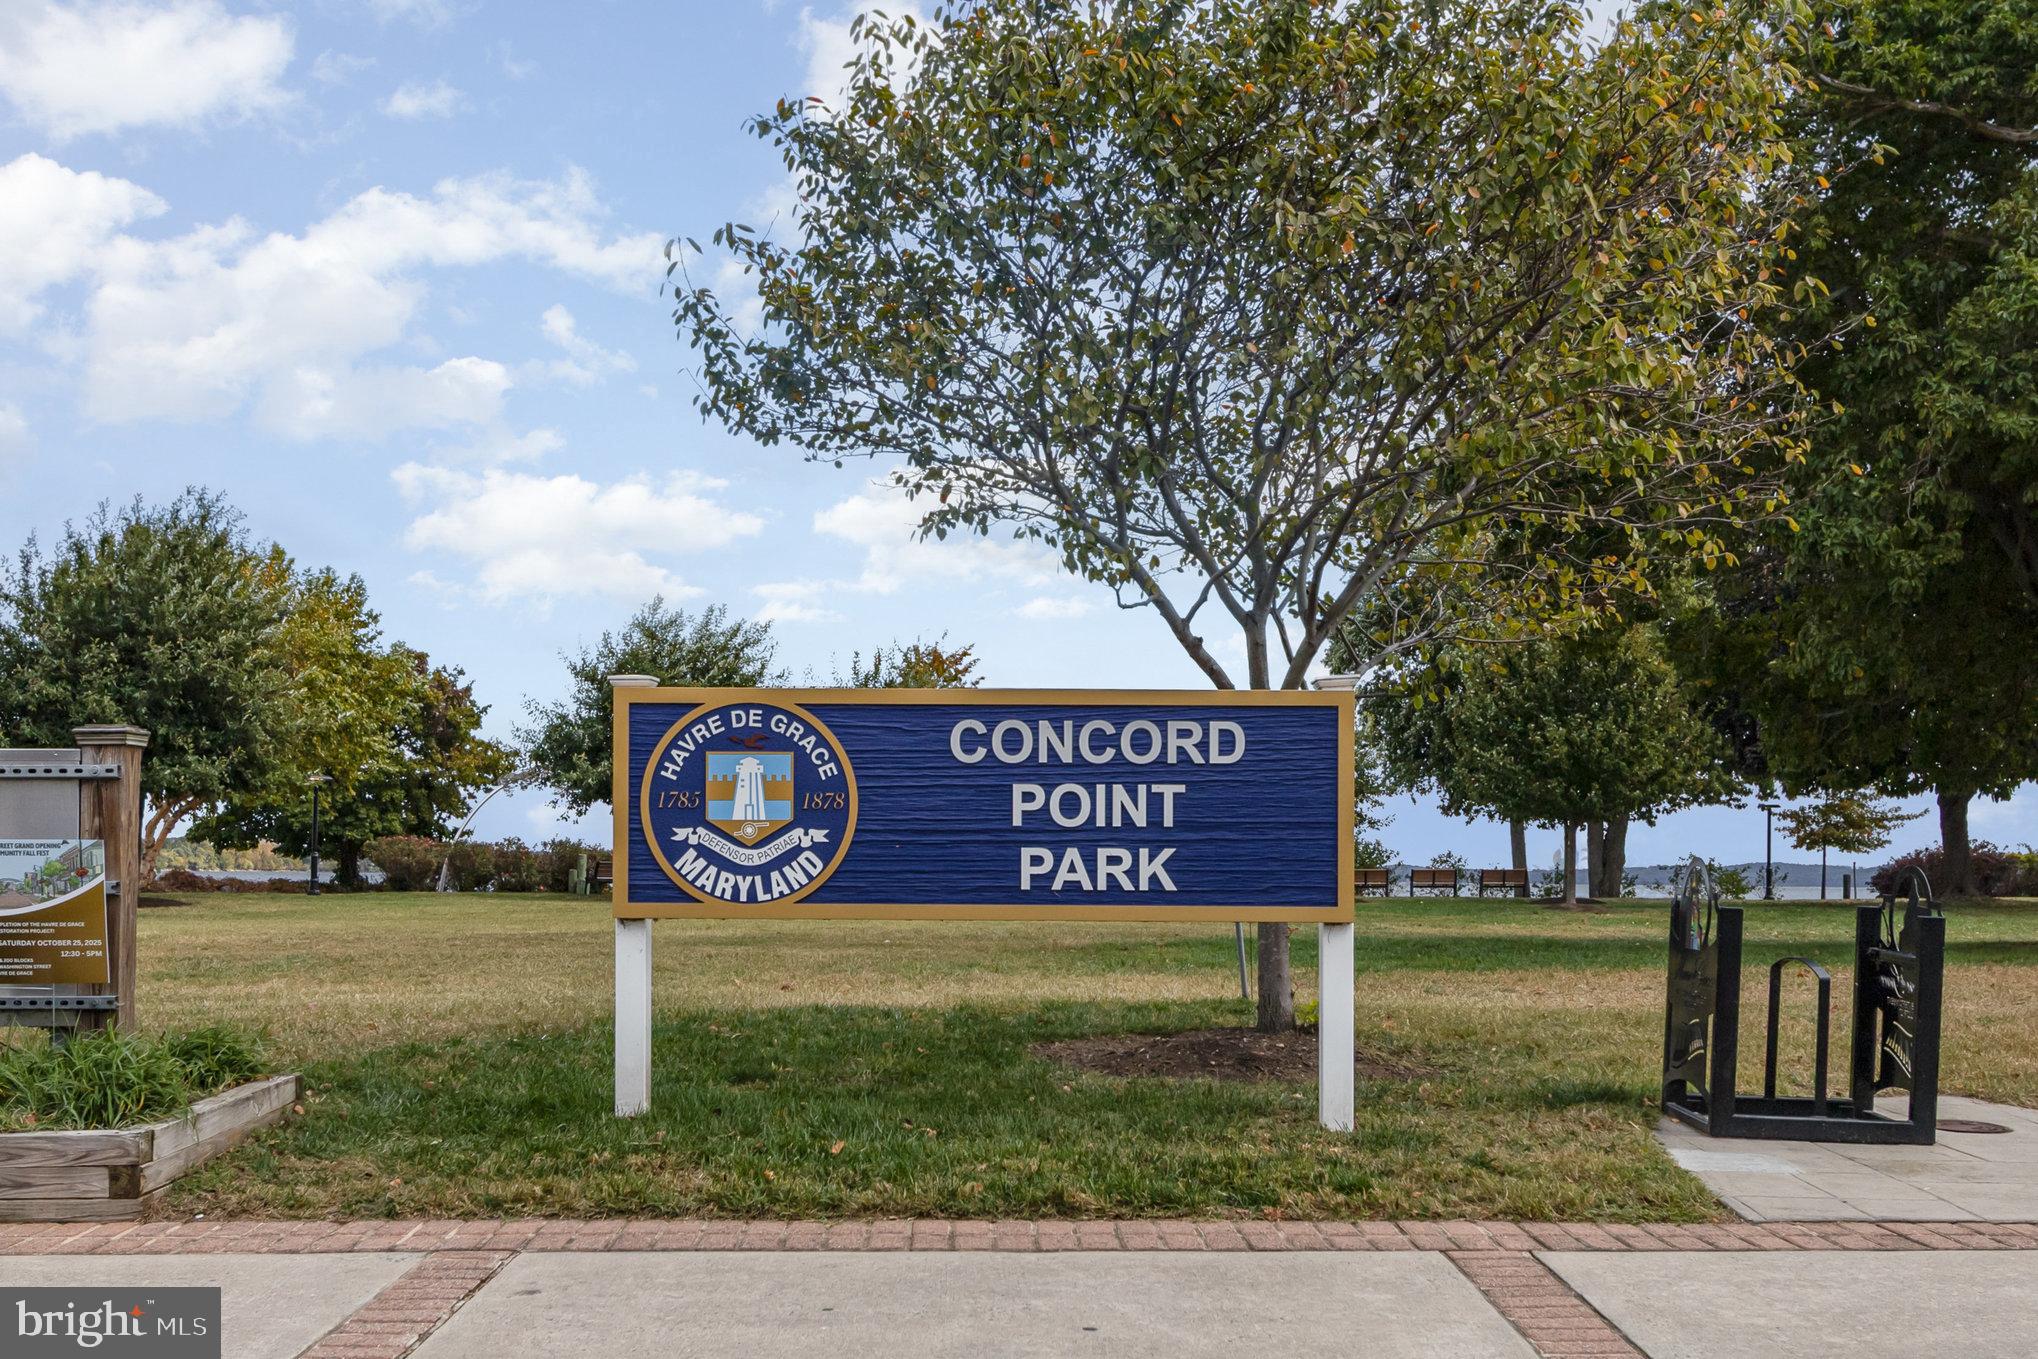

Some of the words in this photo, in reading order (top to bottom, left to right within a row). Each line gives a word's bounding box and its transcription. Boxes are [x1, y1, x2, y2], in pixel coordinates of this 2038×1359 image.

[660, 714, 726, 781] HAVRE
[730, 709, 763, 729] DE
[770, 714, 839, 781] GRACE
[950, 719, 1246, 765] CONCORD
[657, 791, 701, 809] 1785
[802, 792, 846, 810] 1878
[1012, 783, 1186, 828] POINT
[701, 831, 755, 864] DEFENSOR
[757, 834, 796, 862] PATRIAE
[1020, 847, 1178, 891] PARK
[673, 847, 824, 903] MARYLAND
